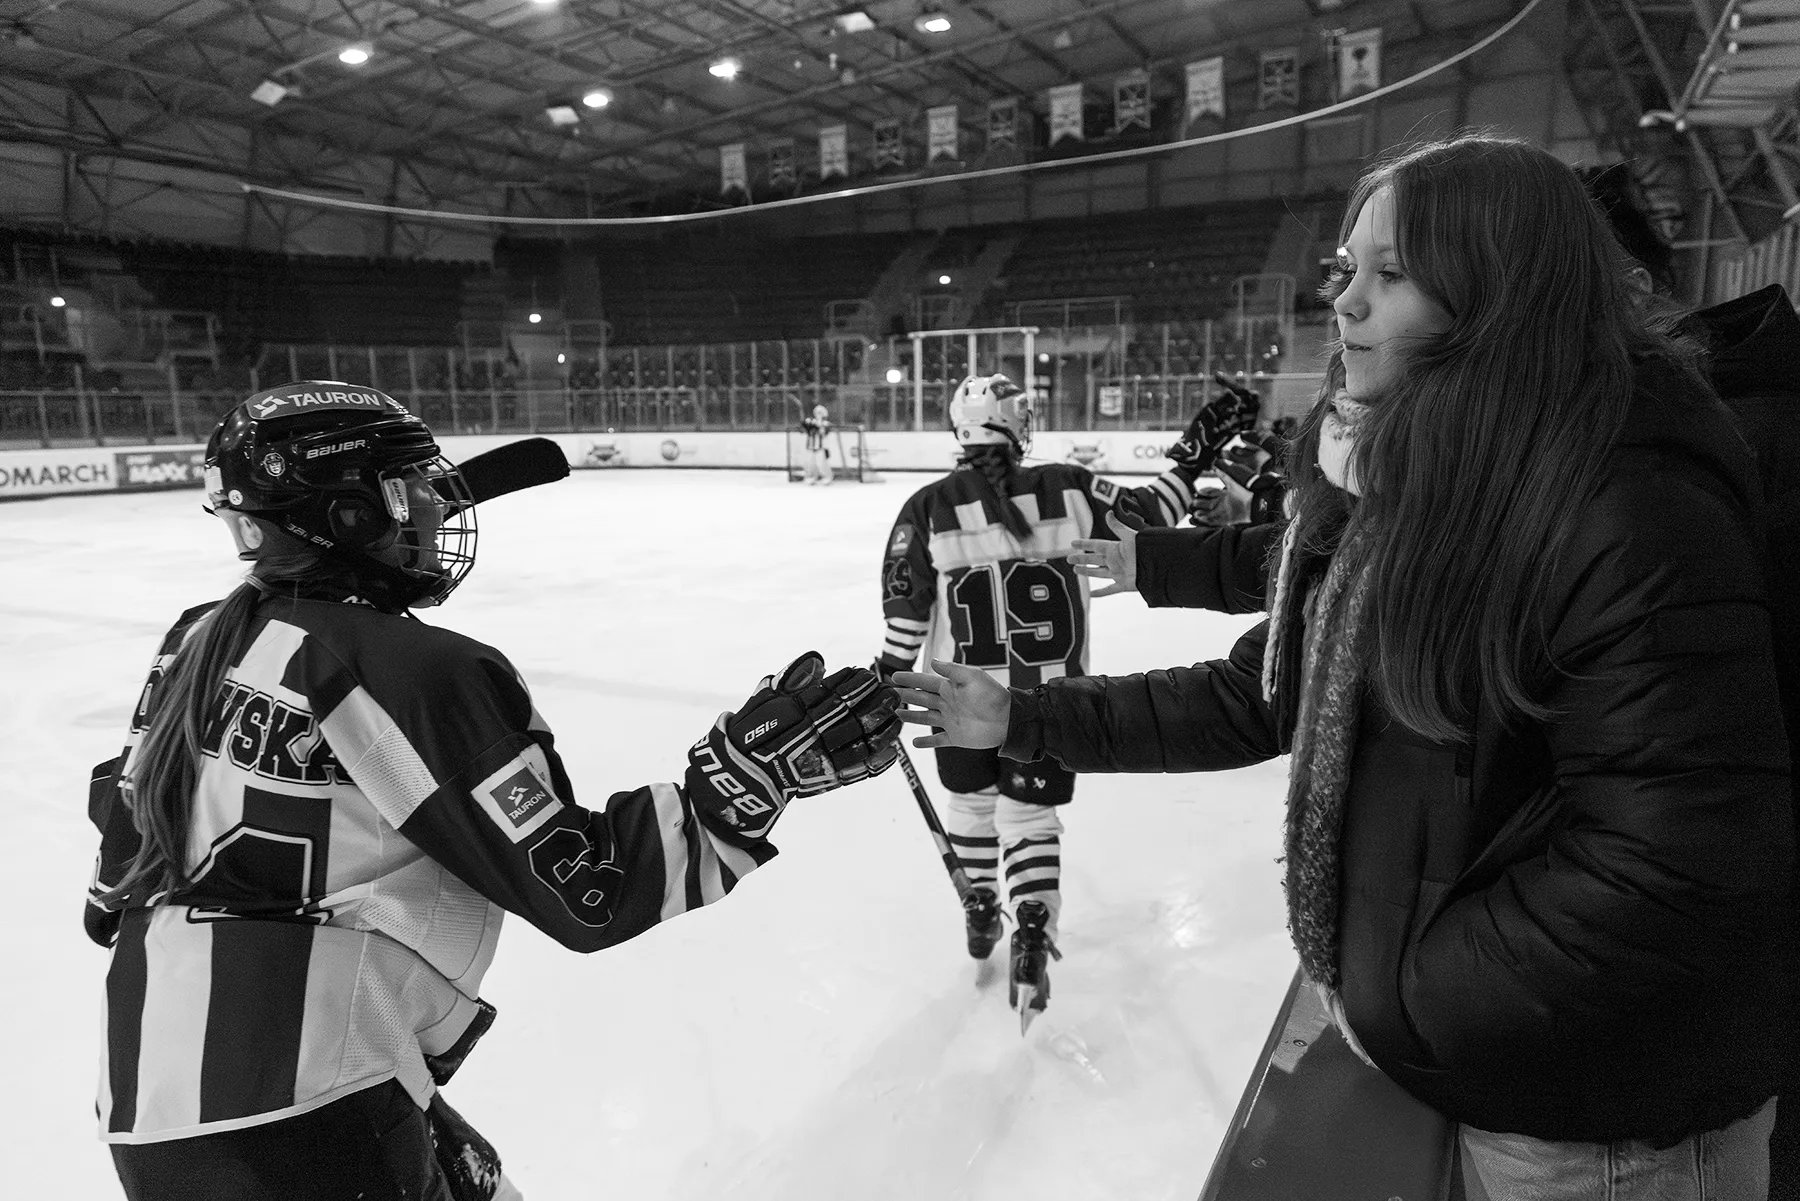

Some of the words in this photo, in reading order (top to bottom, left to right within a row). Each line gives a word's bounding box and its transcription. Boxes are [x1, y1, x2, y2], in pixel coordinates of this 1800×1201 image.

[287, 391, 381, 407] TAURON
[953, 561, 1076, 669] 19
[508, 790, 546, 820] TAURON
